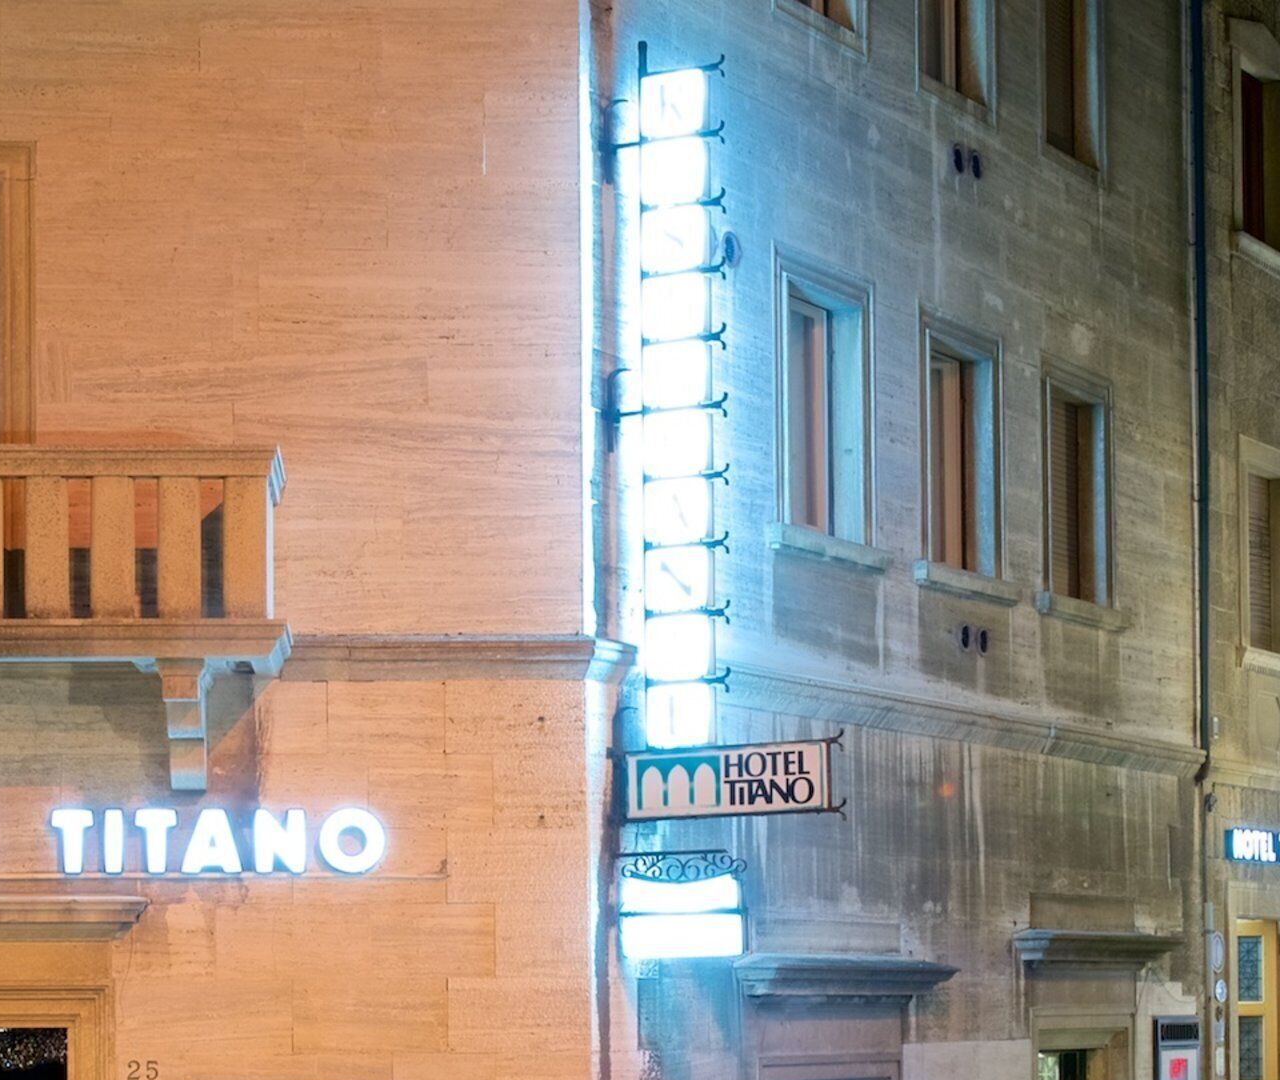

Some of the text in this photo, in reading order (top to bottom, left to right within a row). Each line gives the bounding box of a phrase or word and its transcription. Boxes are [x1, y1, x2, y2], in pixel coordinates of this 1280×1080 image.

[724, 750, 810, 778] HOTEL
[51, 806, 388, 877] TITANO
[1232, 828, 1277, 862] HOTEL
[126, 1060, 160, 1080] 25
